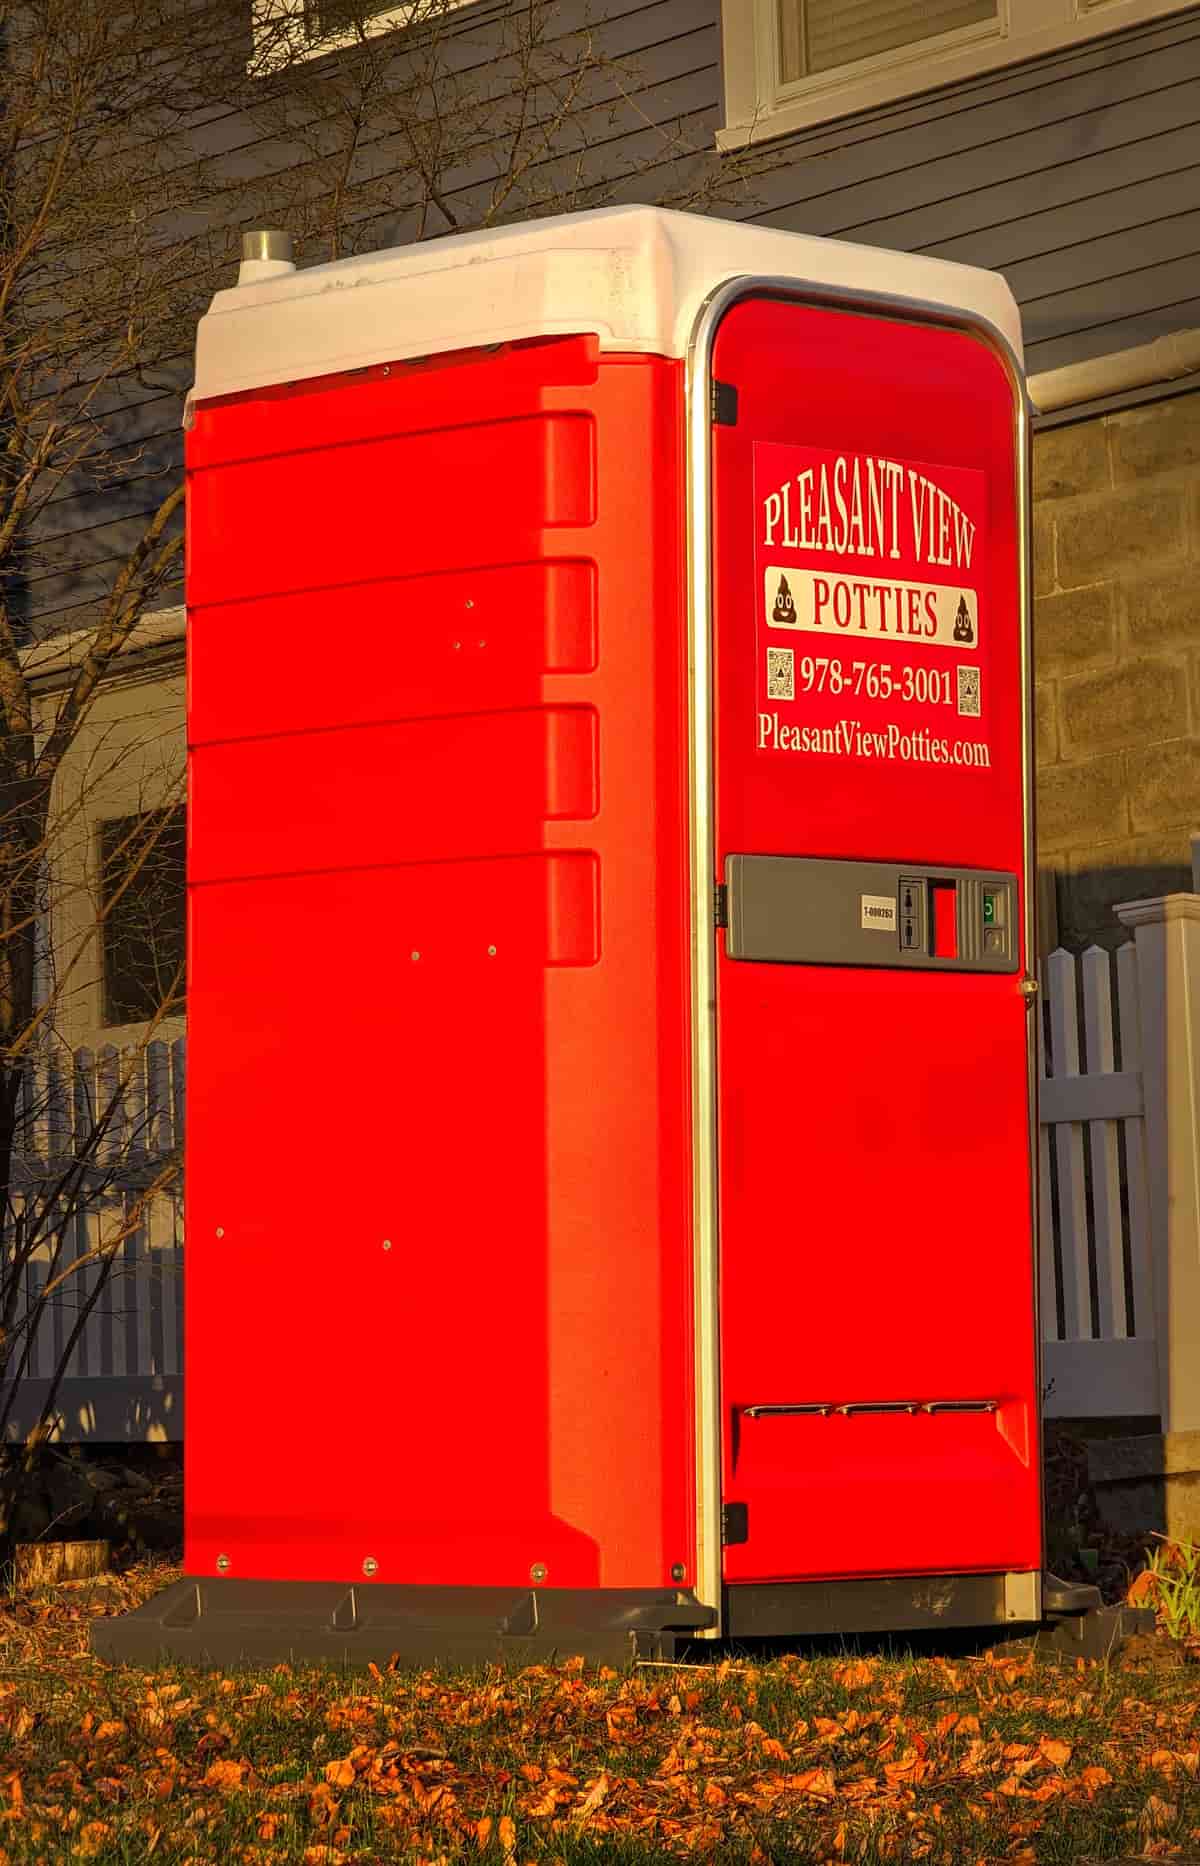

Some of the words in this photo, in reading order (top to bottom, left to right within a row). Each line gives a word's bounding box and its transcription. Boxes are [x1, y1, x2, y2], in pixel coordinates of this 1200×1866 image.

[763, 456, 904, 559] PLEASANT
[907, 469, 976, 569] VIEW
[812, 577, 938, 637] POTTIES
[800, 656, 953, 705] 978-765-3001
[758, 712, 991, 768] PleasantViewPotties.com
